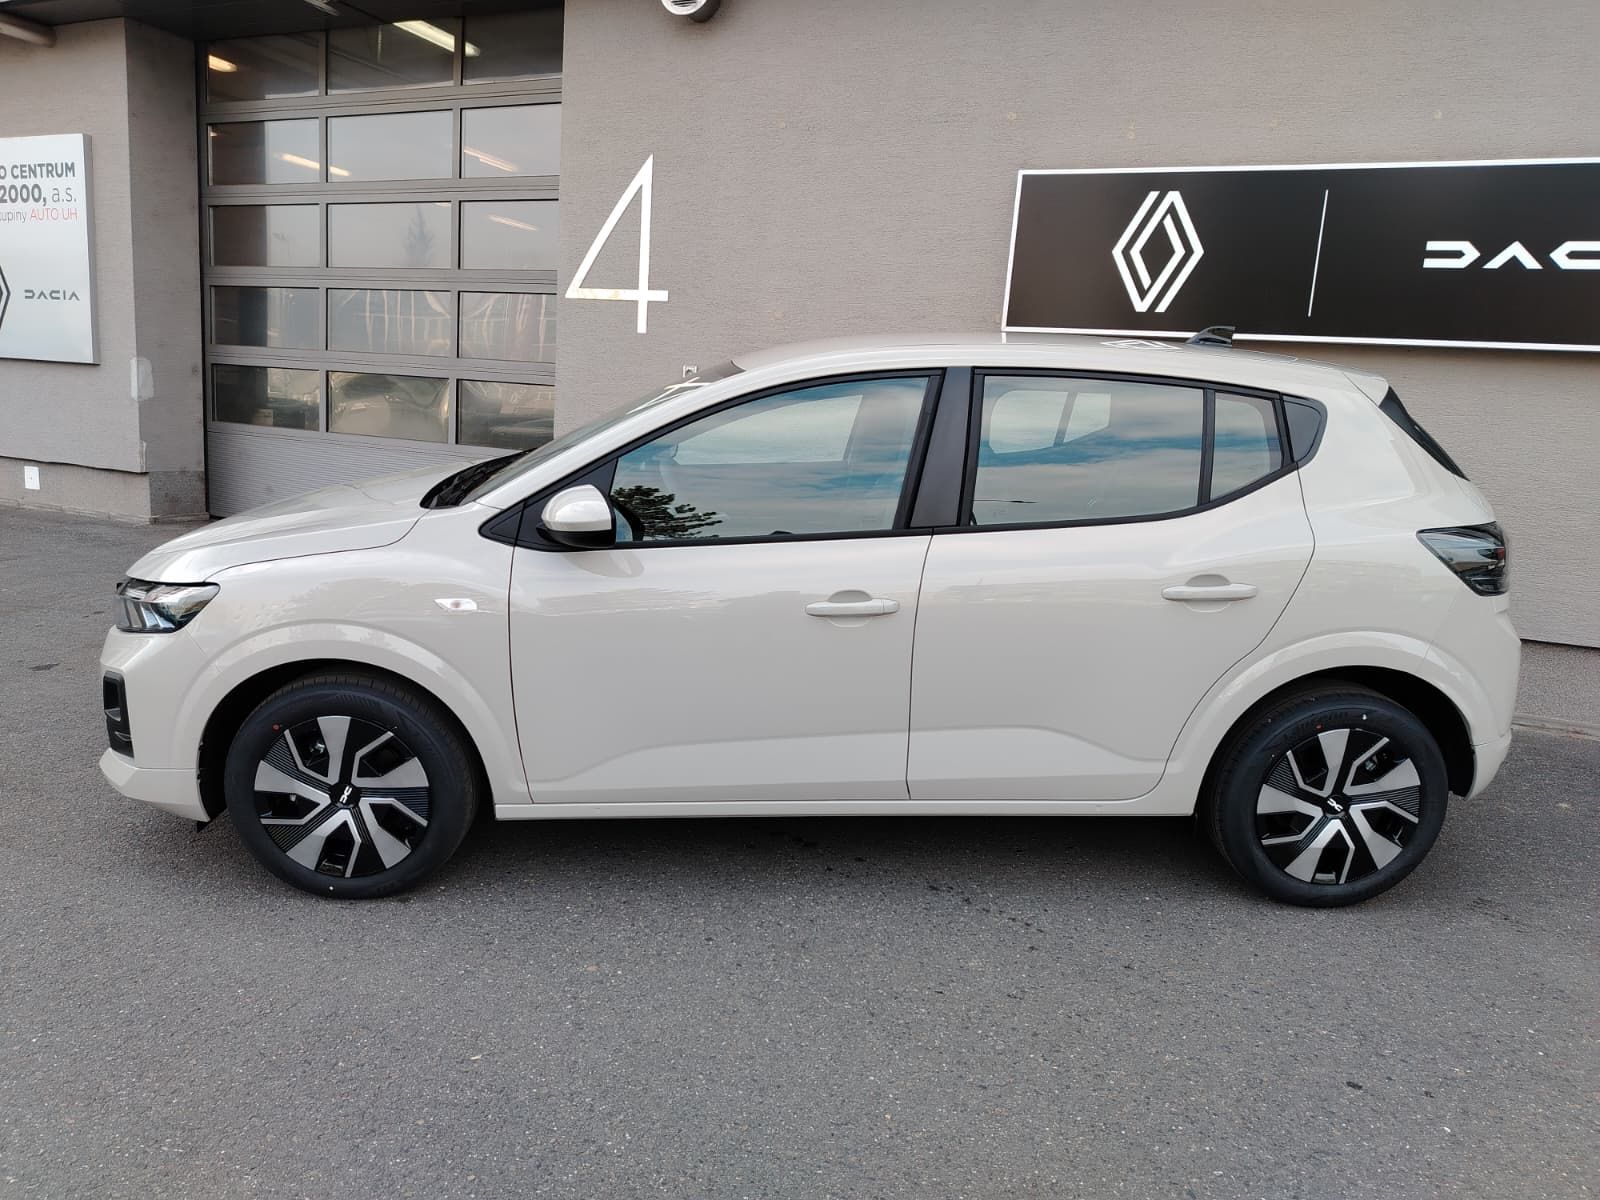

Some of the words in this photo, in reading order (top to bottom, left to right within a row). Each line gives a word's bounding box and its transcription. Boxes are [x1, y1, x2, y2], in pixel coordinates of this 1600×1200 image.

[11, 162, 75, 179] CENTRUM
[0, 184, 46, 206] 2000,
[52, 187, 77, 203] a.s.
[0, 211, 27, 223] upiny
[30, 208, 58, 220] AUTO
[62, 207, 78, 220] UH
[564, 153, 669, 333] 4
[24, 289, 80, 301] DACIA
